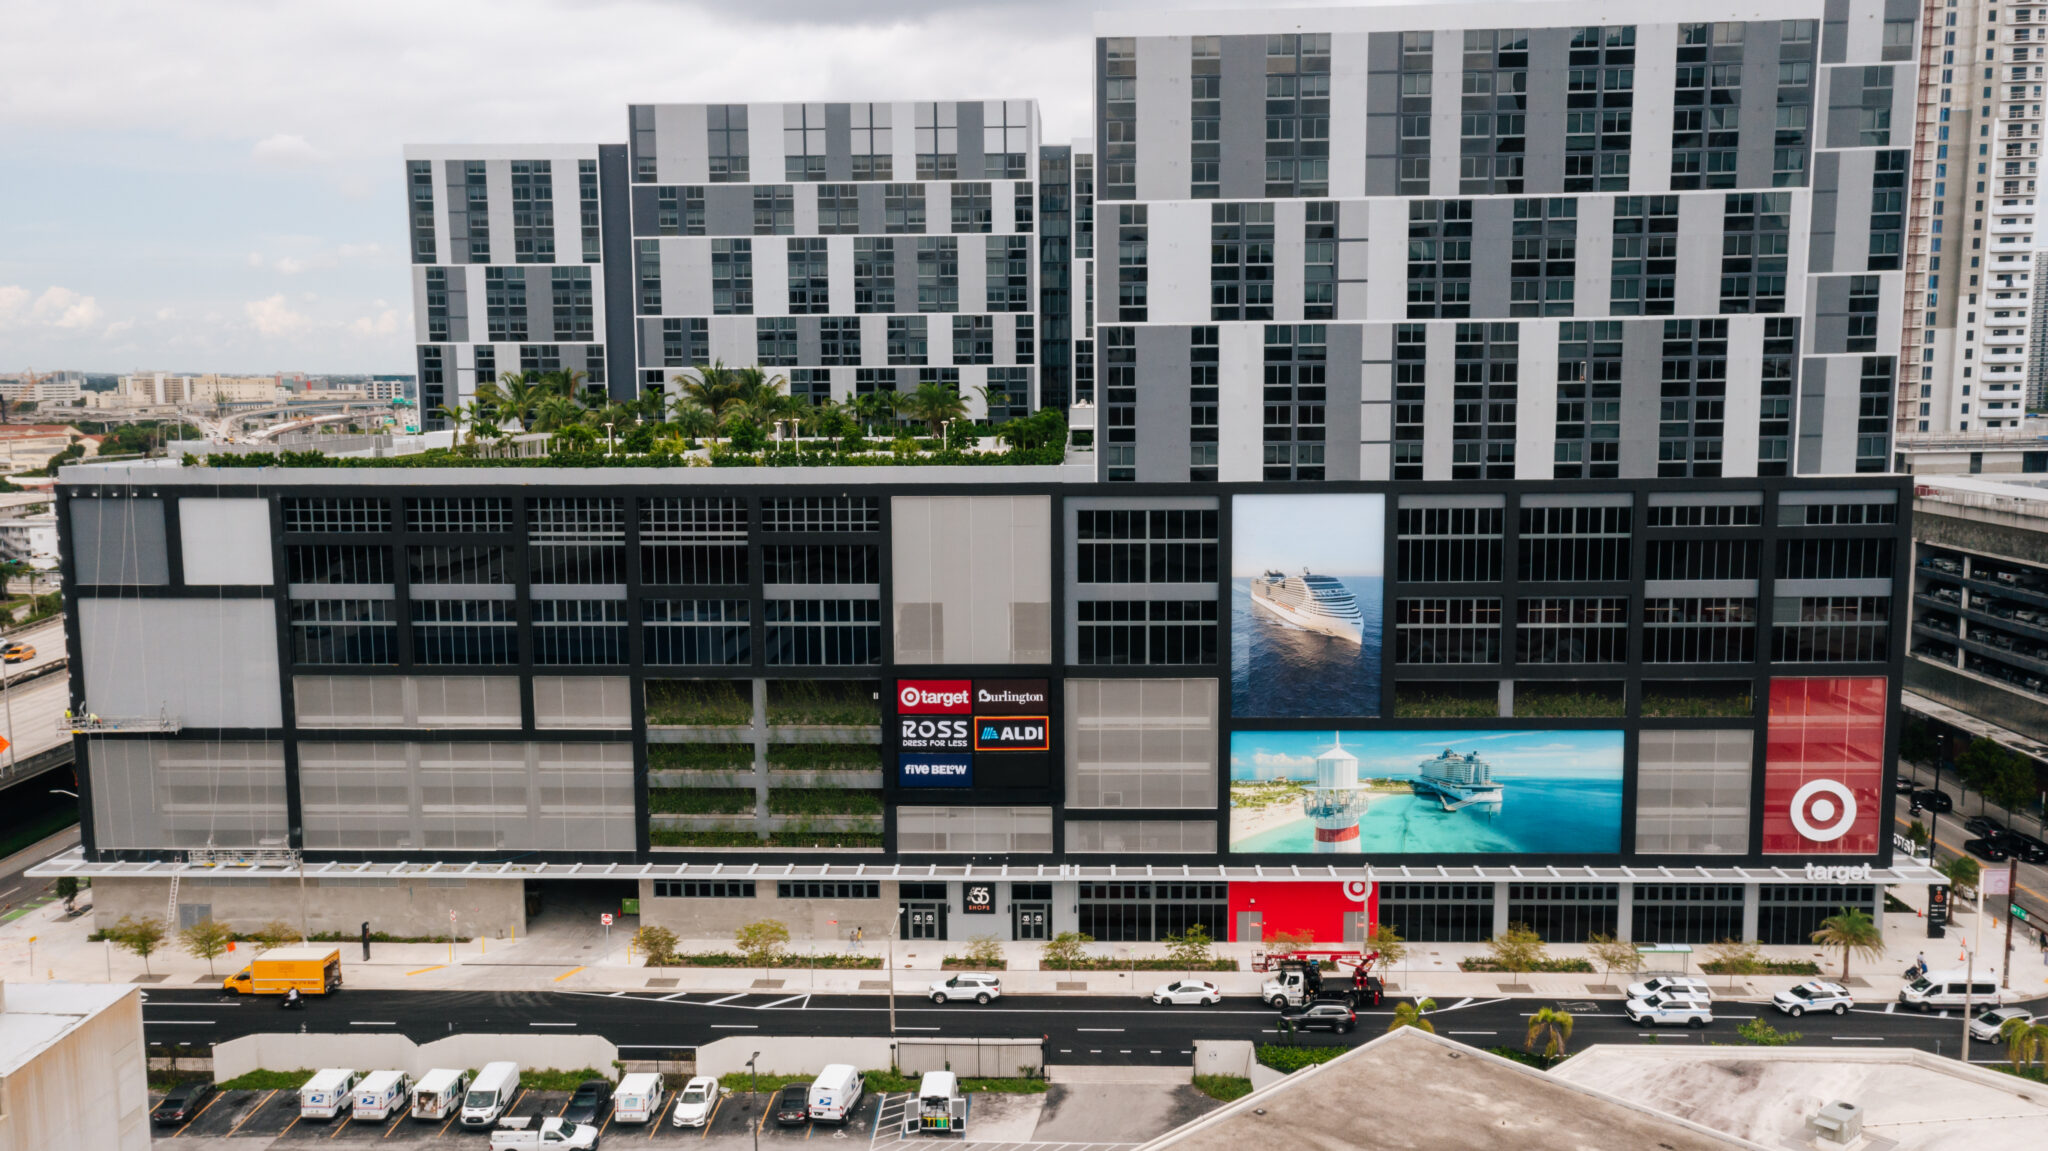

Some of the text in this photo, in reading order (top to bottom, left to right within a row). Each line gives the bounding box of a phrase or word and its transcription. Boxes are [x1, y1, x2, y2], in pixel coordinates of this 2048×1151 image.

[921, 690, 969, 707] target
[978, 689, 1044, 705] Burlington
[902, 720, 968, 738] ROSS
[1000, 726, 1044, 740] ALDI
[902, 739, 968, 747] DRESS FOR LESS
[1804, 862, 1872, 885] target
[971, 887, 990, 905] 55
